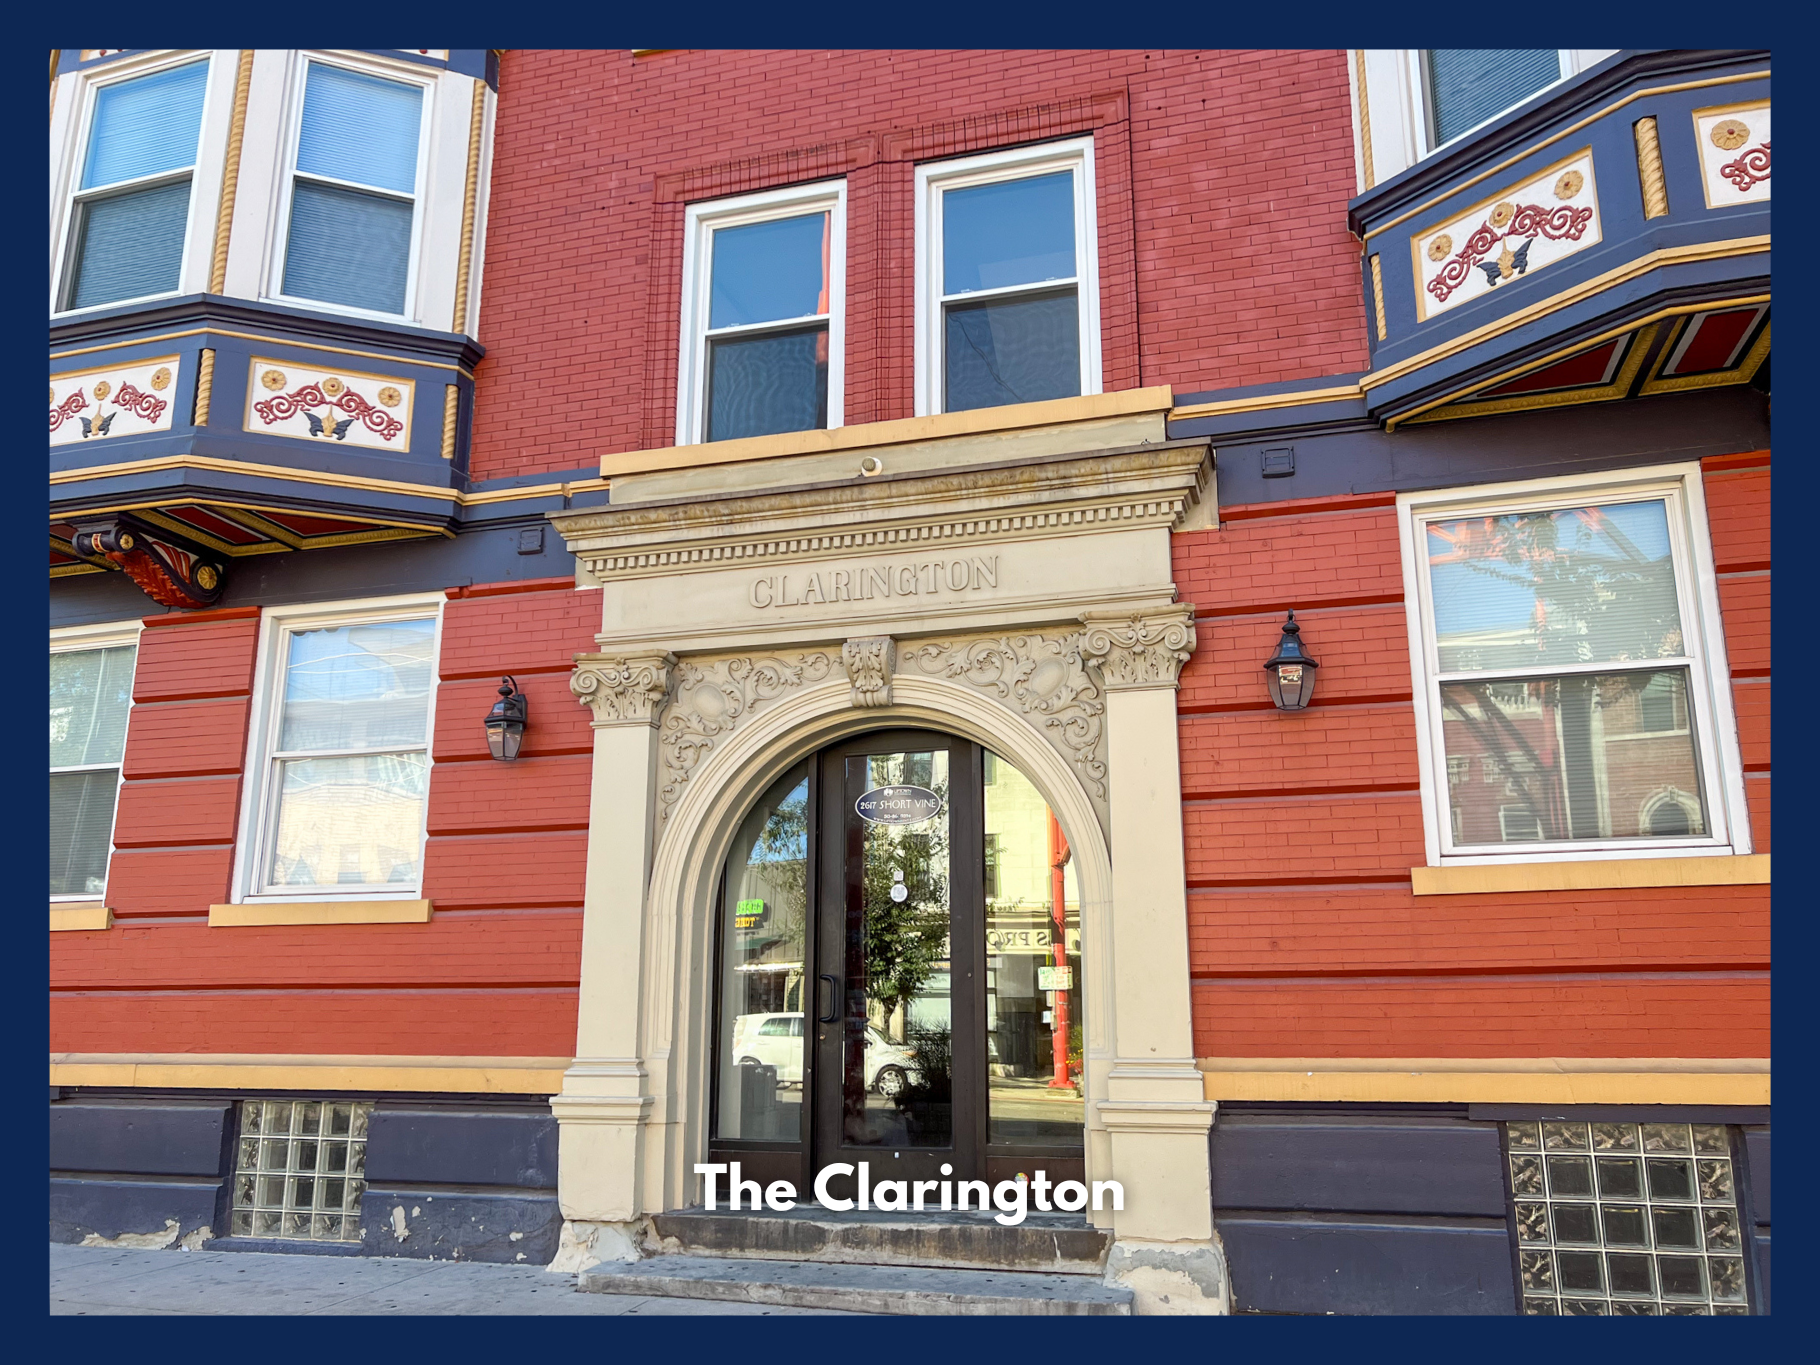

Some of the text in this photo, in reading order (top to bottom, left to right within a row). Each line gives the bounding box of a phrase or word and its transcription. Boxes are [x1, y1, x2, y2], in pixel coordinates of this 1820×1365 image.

[748, 555, 999, 608] CLARINGTON
[860, 798, 936, 810] 2617 SHORT VINE
